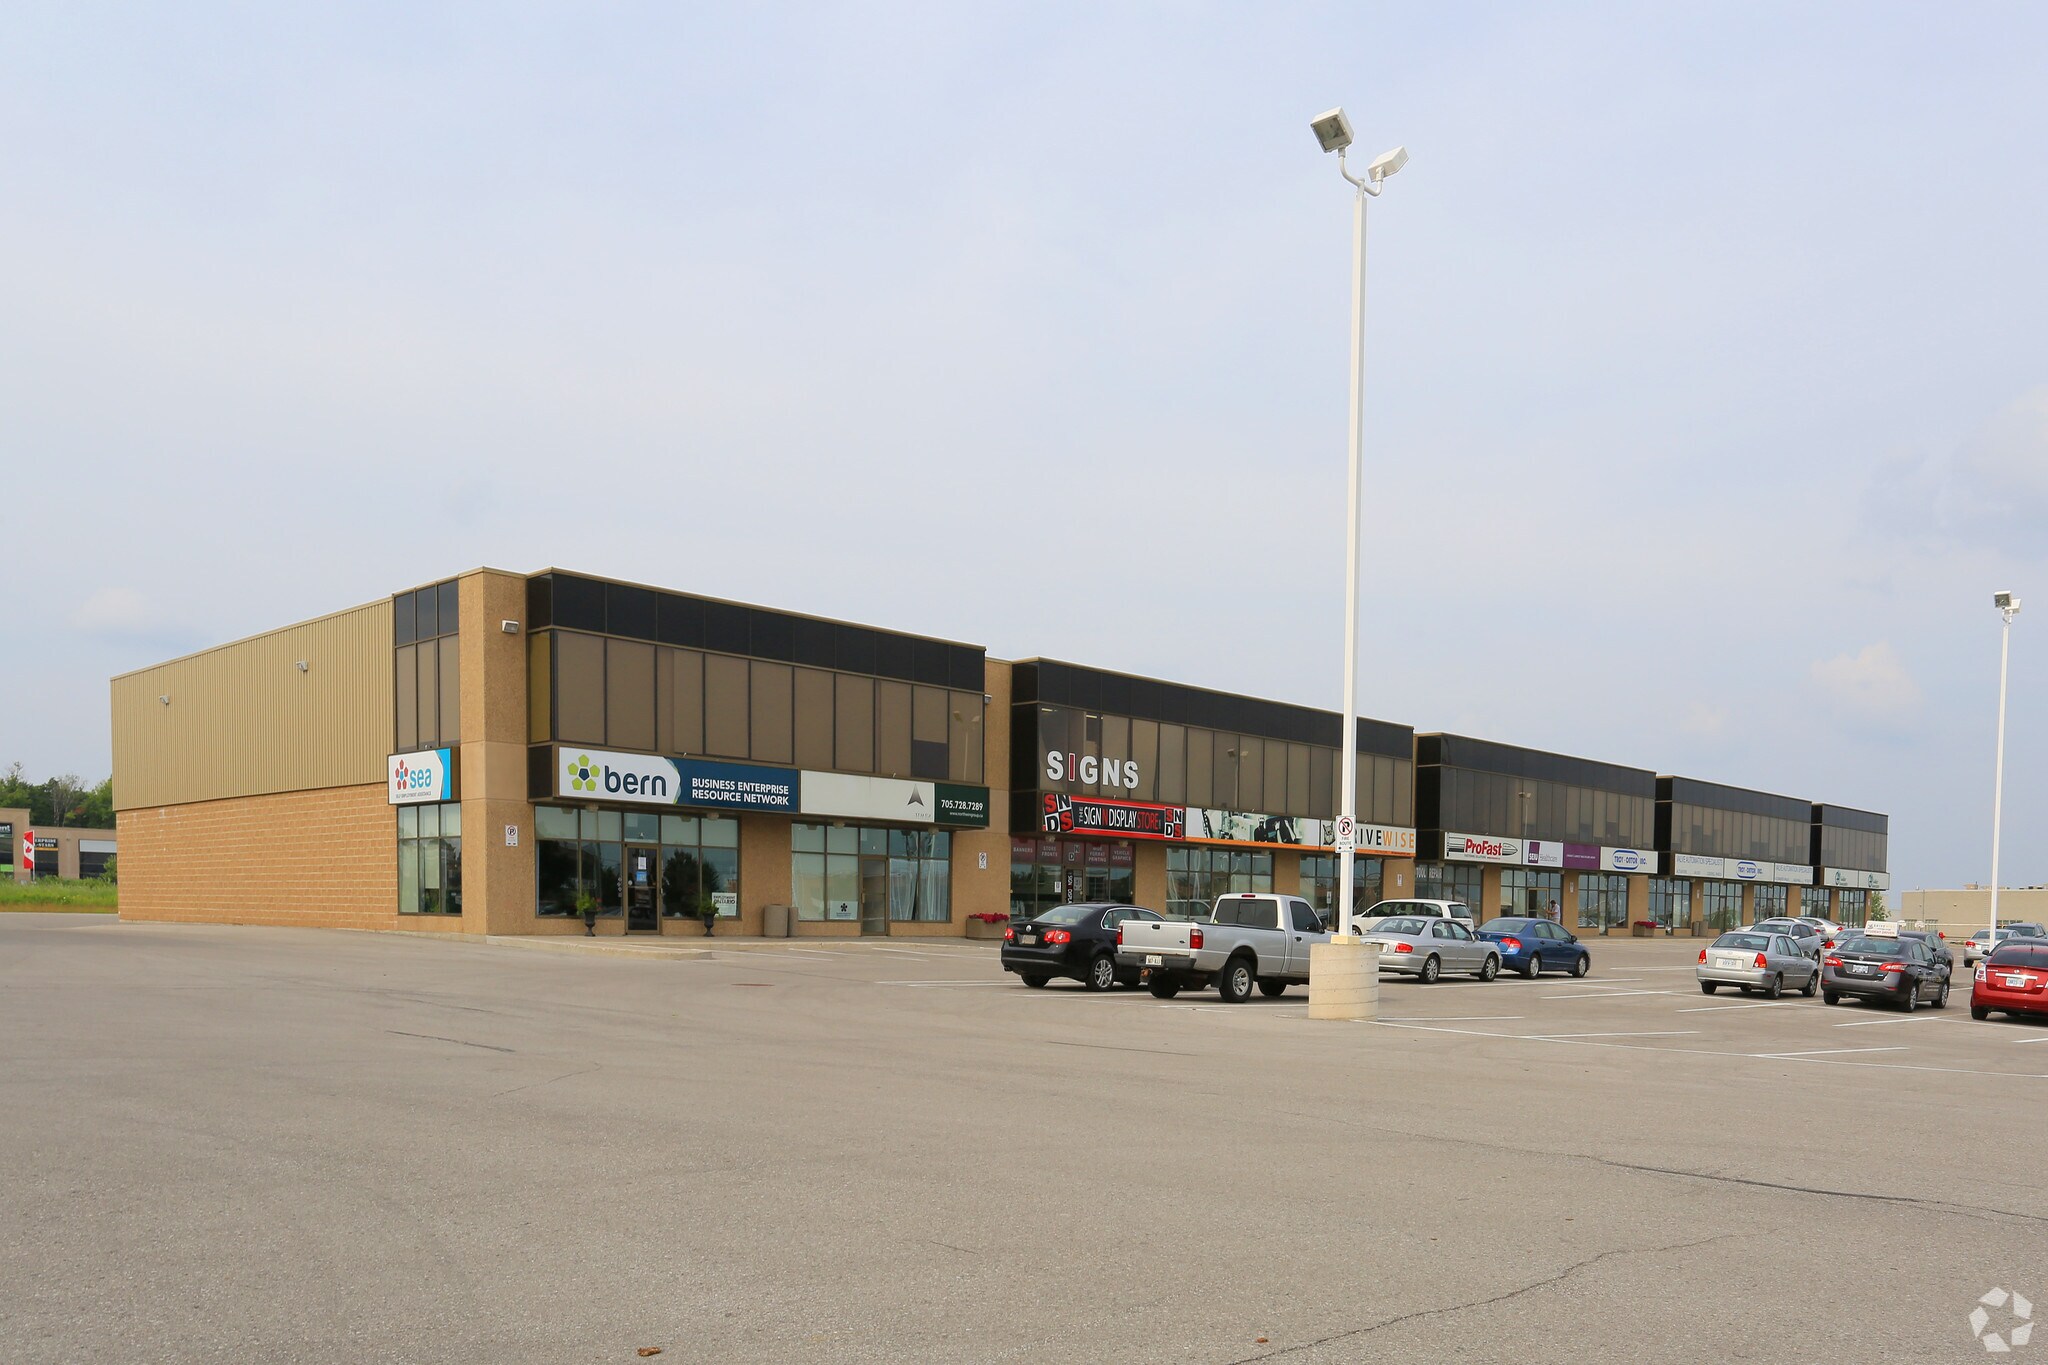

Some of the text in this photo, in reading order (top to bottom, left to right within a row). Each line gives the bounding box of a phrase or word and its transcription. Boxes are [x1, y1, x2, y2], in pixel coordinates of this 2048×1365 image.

[410, 768, 432, 789] sea
[1046, 750, 1139, 789] SIGNS
[604, 765, 667, 797] bern
[692, 777, 789, 795] BUSINESS ENTERPRISE
[692, 789, 789, 806] RESOURCE NETWORK
[941, 799, 984, 812] 705.728.7289
[1083, 806, 1102, 826] SIGN
[1108, 808, 1138, 829] DISPLAY
[1137, 811, 1159, 831] STORE
[1465, 838, 1503, 856] ProFast
